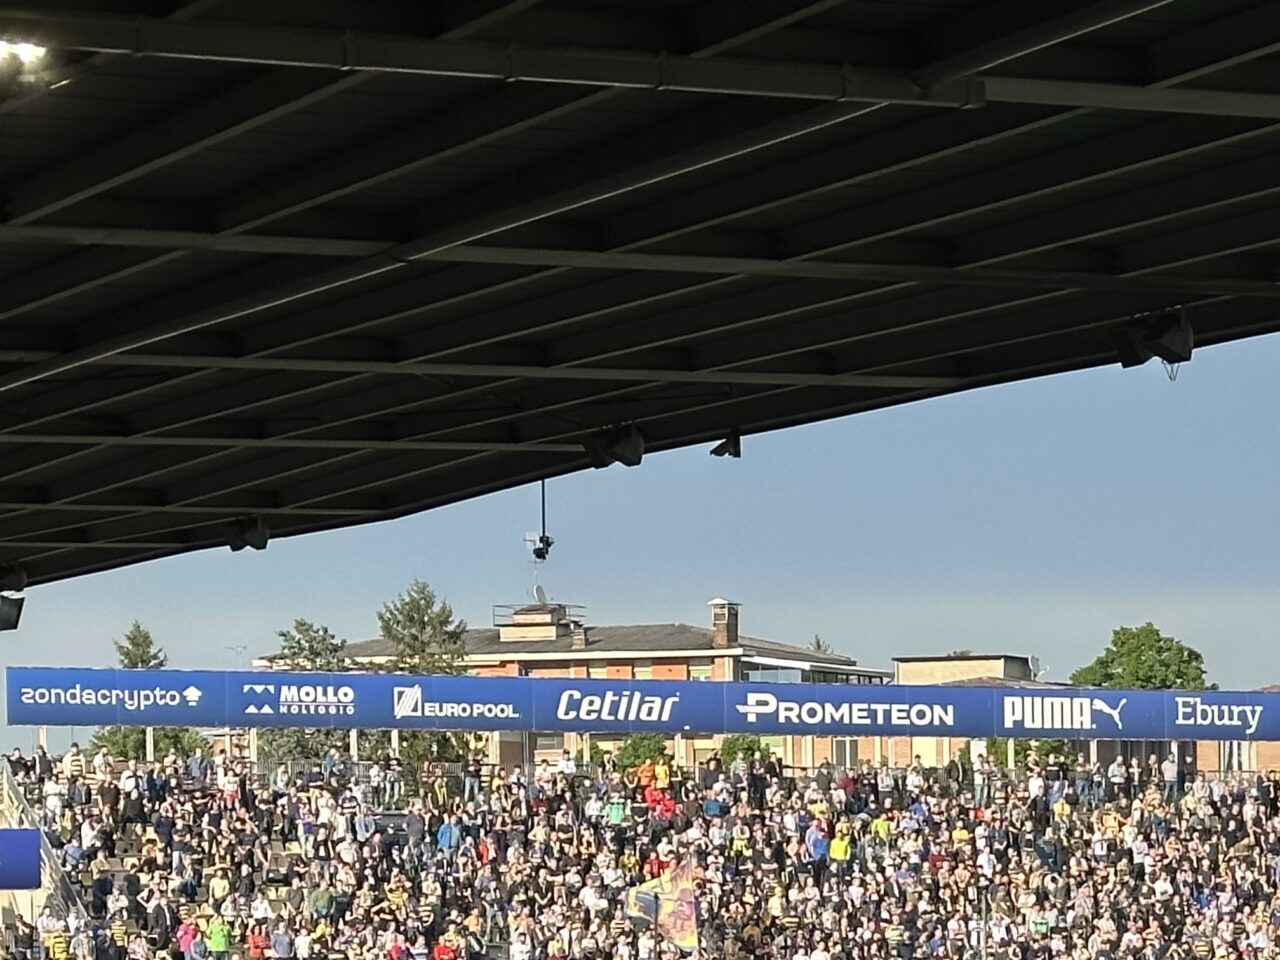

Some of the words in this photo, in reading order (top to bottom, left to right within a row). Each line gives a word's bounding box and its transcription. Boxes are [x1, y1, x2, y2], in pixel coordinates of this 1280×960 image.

[21, 684, 180, 711] zondacrypto
[279, 703, 355, 715] NOLEGGIO
[280, 685, 355, 703] MOLLO
[557, 689, 680, 721] Cetilar
[736, 692, 954, 726] PROMETEON
[1003, 696, 1096, 730] PUMA
[1175, 697, 1263, 735] Ebury
